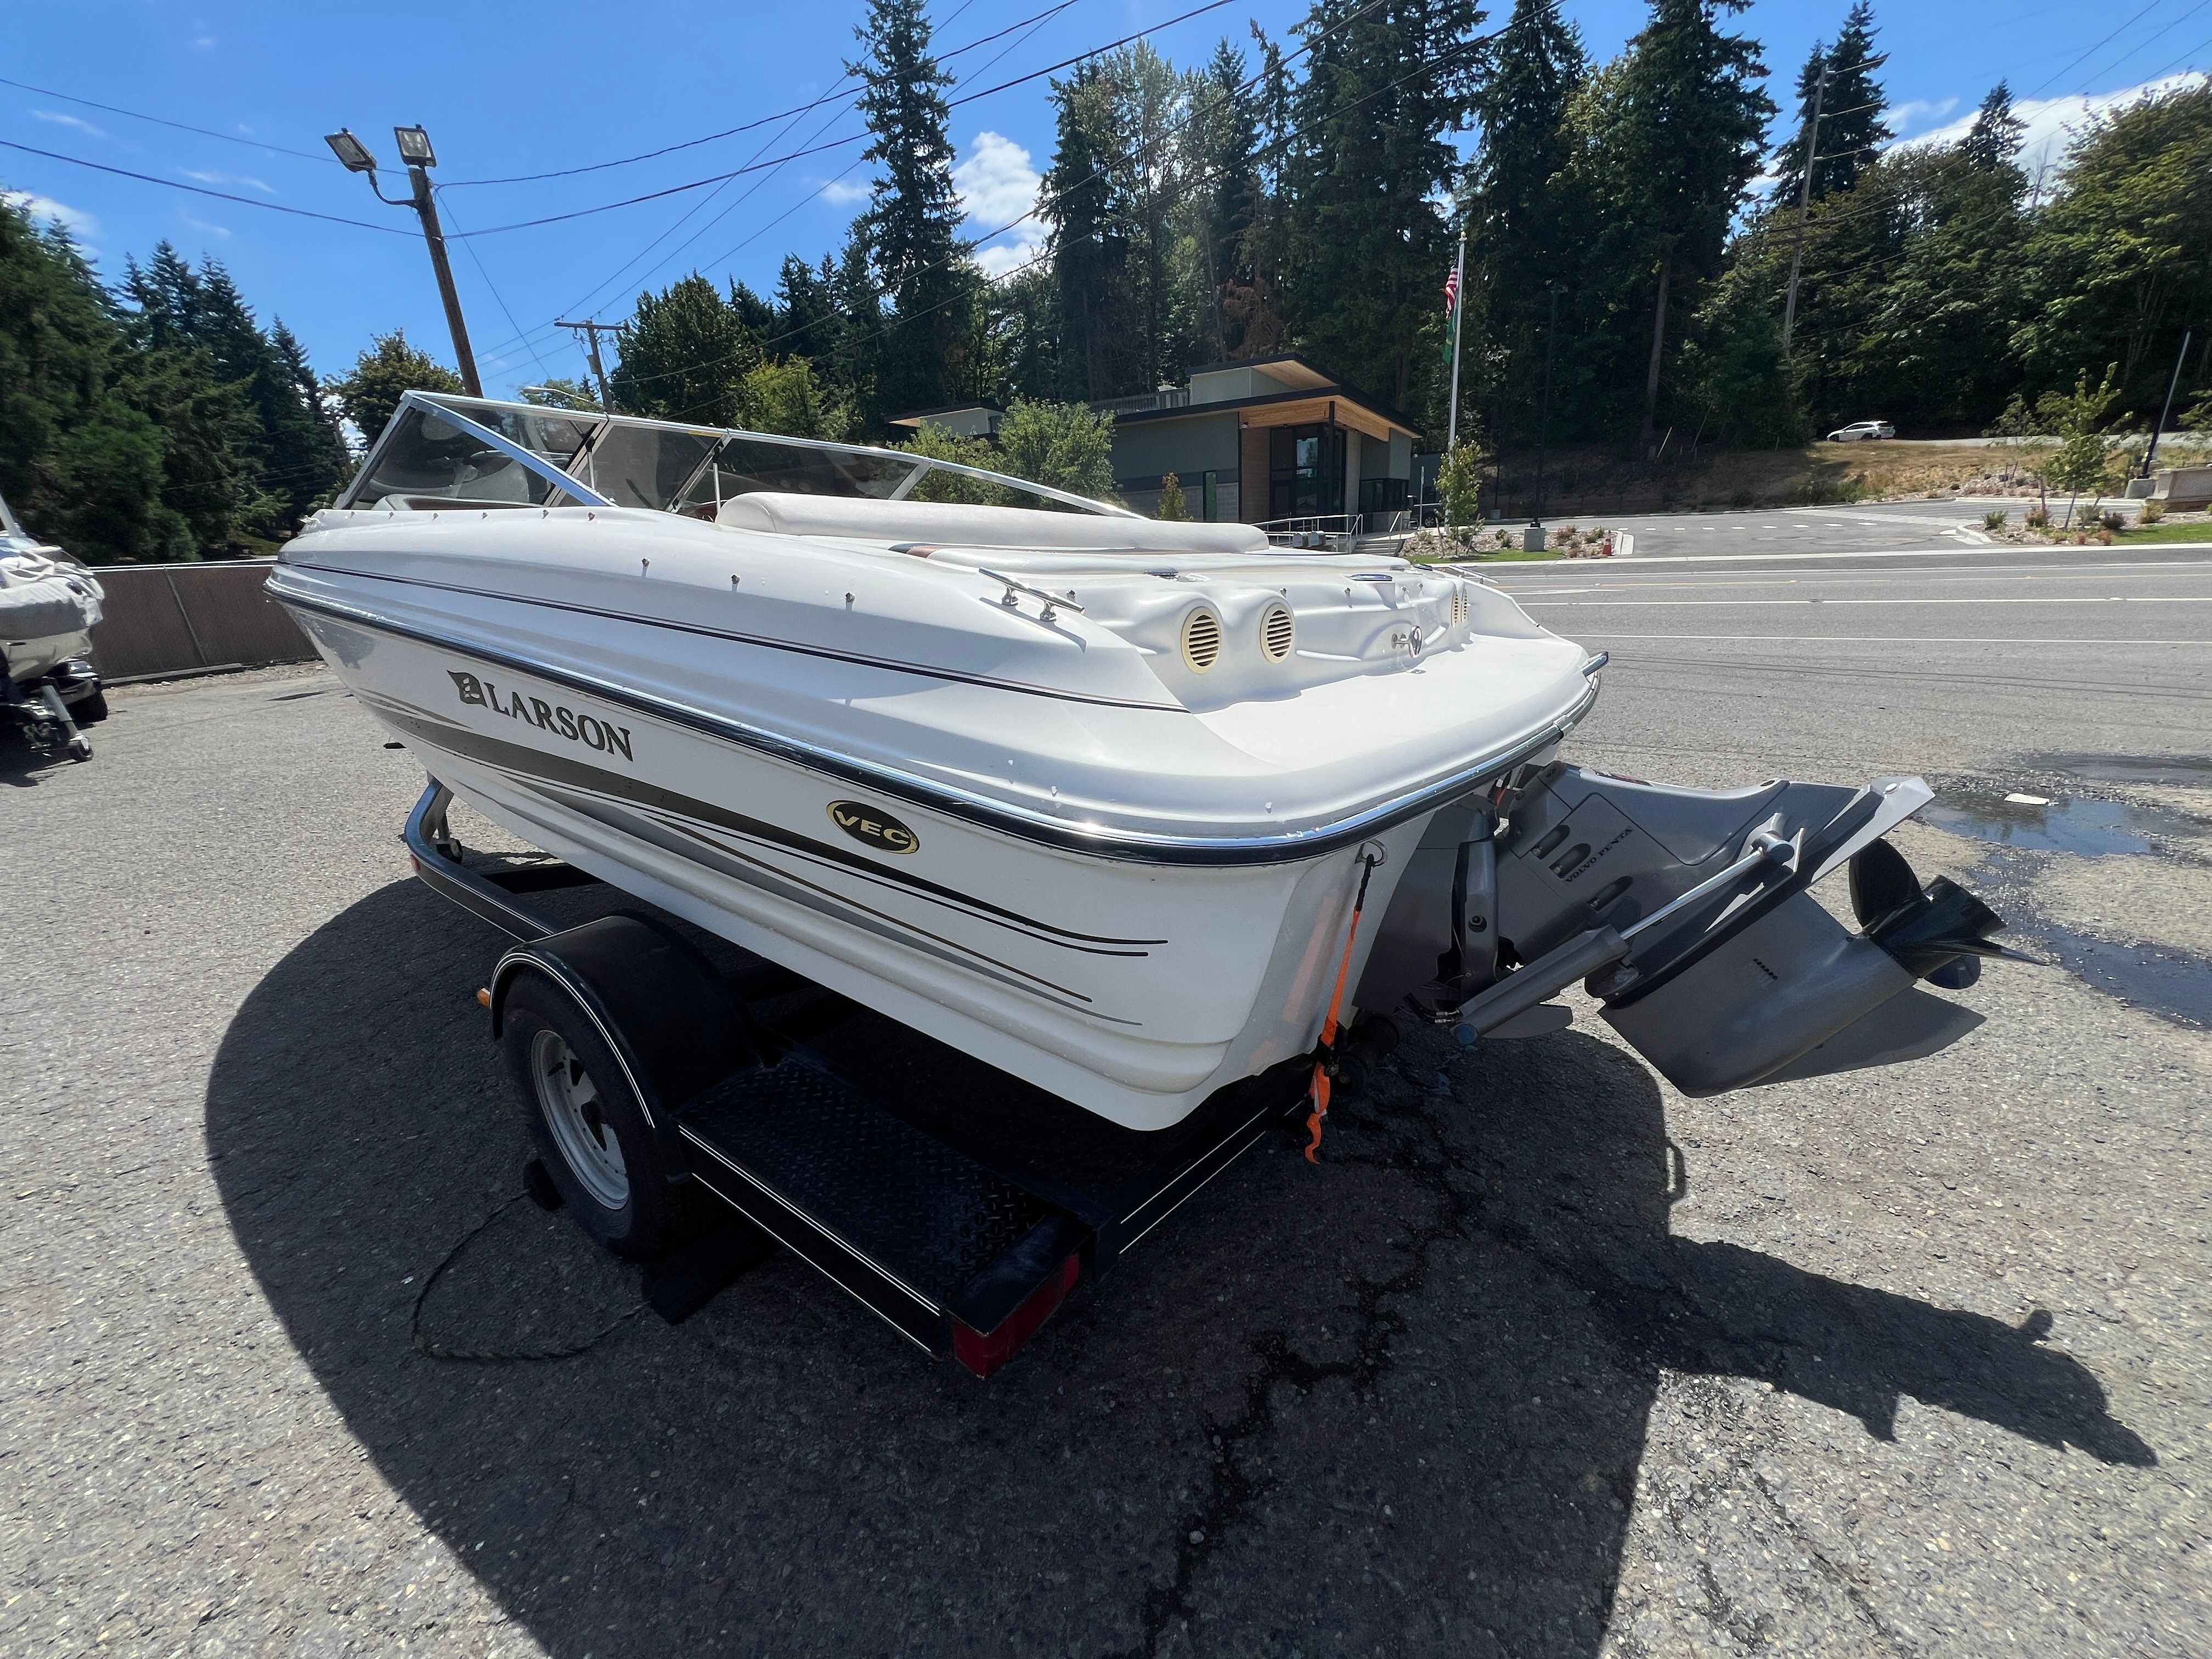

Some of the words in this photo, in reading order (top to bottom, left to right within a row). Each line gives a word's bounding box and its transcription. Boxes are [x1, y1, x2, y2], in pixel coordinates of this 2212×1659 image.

[484, 682, 633, 762] LARSON
[834, 810, 910, 844] VEC
[1565, 857, 1598, 882] VOLVO
[1598, 828, 1633, 857] PENTA
